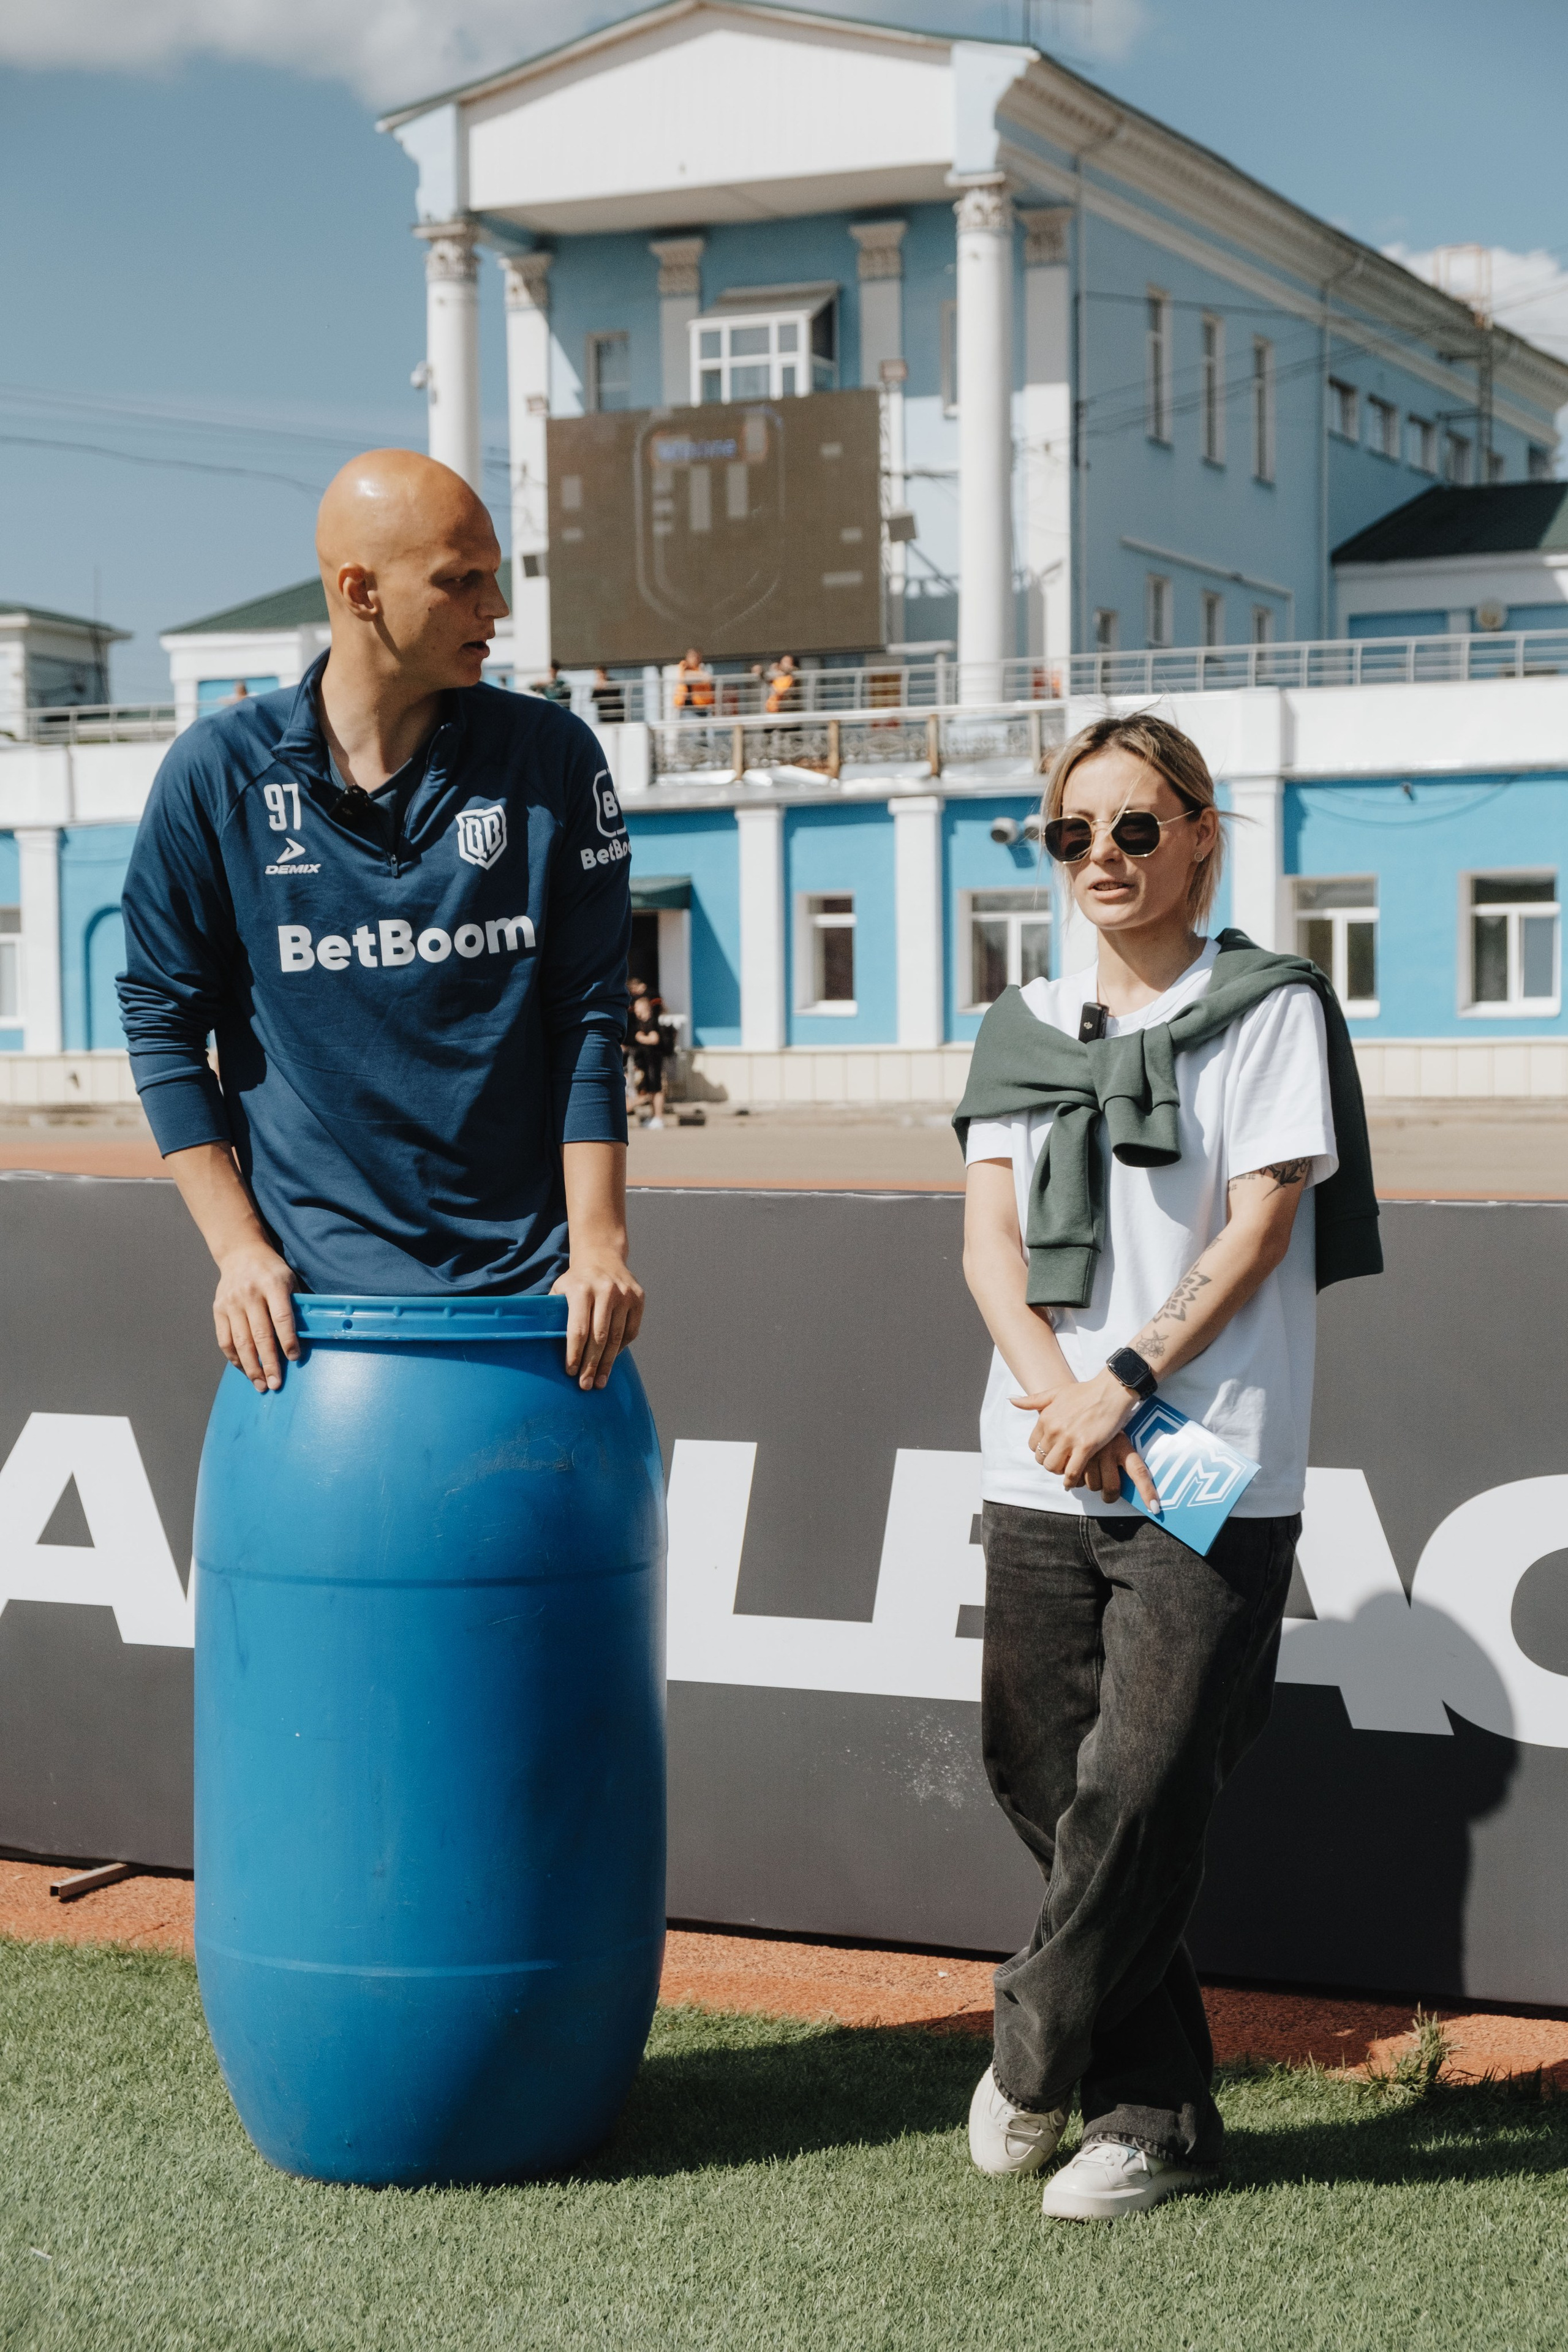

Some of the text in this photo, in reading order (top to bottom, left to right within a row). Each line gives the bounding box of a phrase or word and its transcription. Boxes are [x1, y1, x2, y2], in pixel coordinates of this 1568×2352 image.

[263, 783, 301, 831] 97
[265, 864, 322, 875] DEMIX
[581, 839, 631, 870] BetBo
[277, 915, 537, 973] BetBoom
